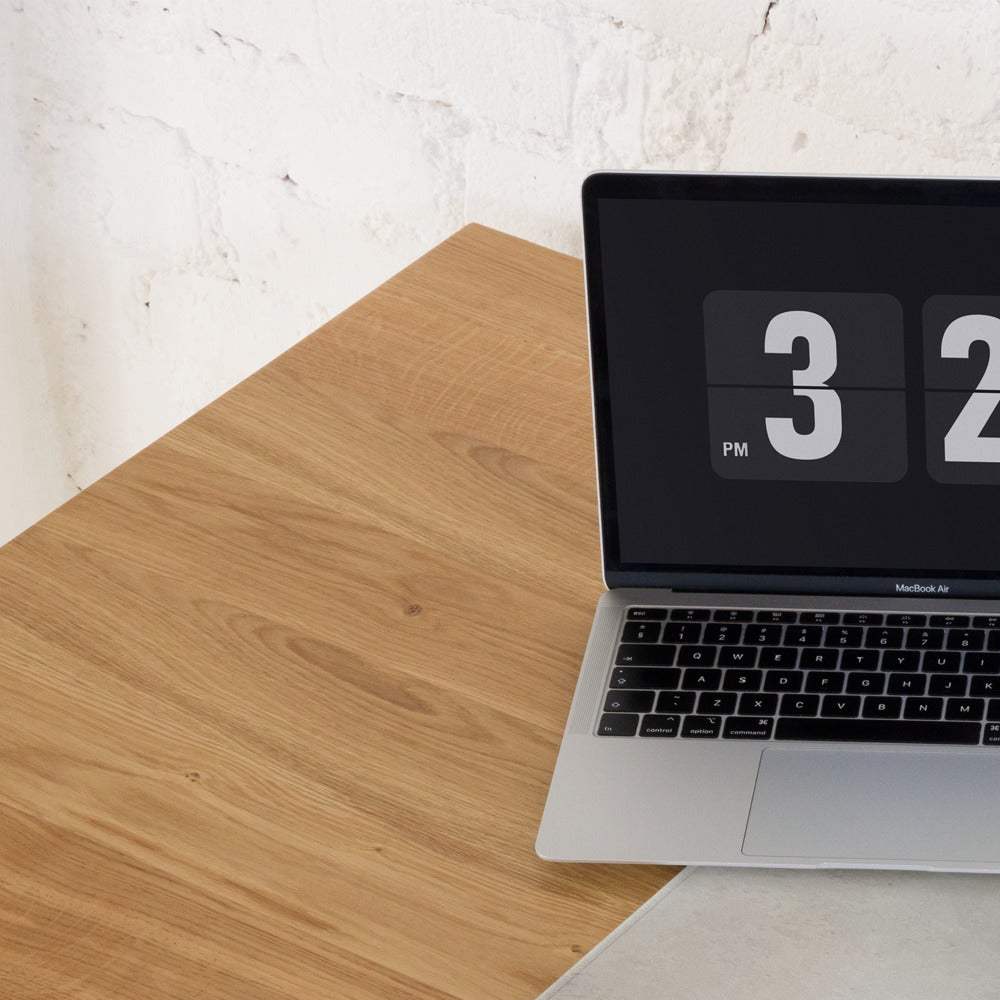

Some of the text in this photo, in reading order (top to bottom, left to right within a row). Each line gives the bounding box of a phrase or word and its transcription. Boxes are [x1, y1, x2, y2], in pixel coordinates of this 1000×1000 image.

[763, 310, 843, 461] 3
[722, 440, 750, 459] PM
[895, 583, 950, 593] MacBook Air
[689, 728, 714, 736] option
